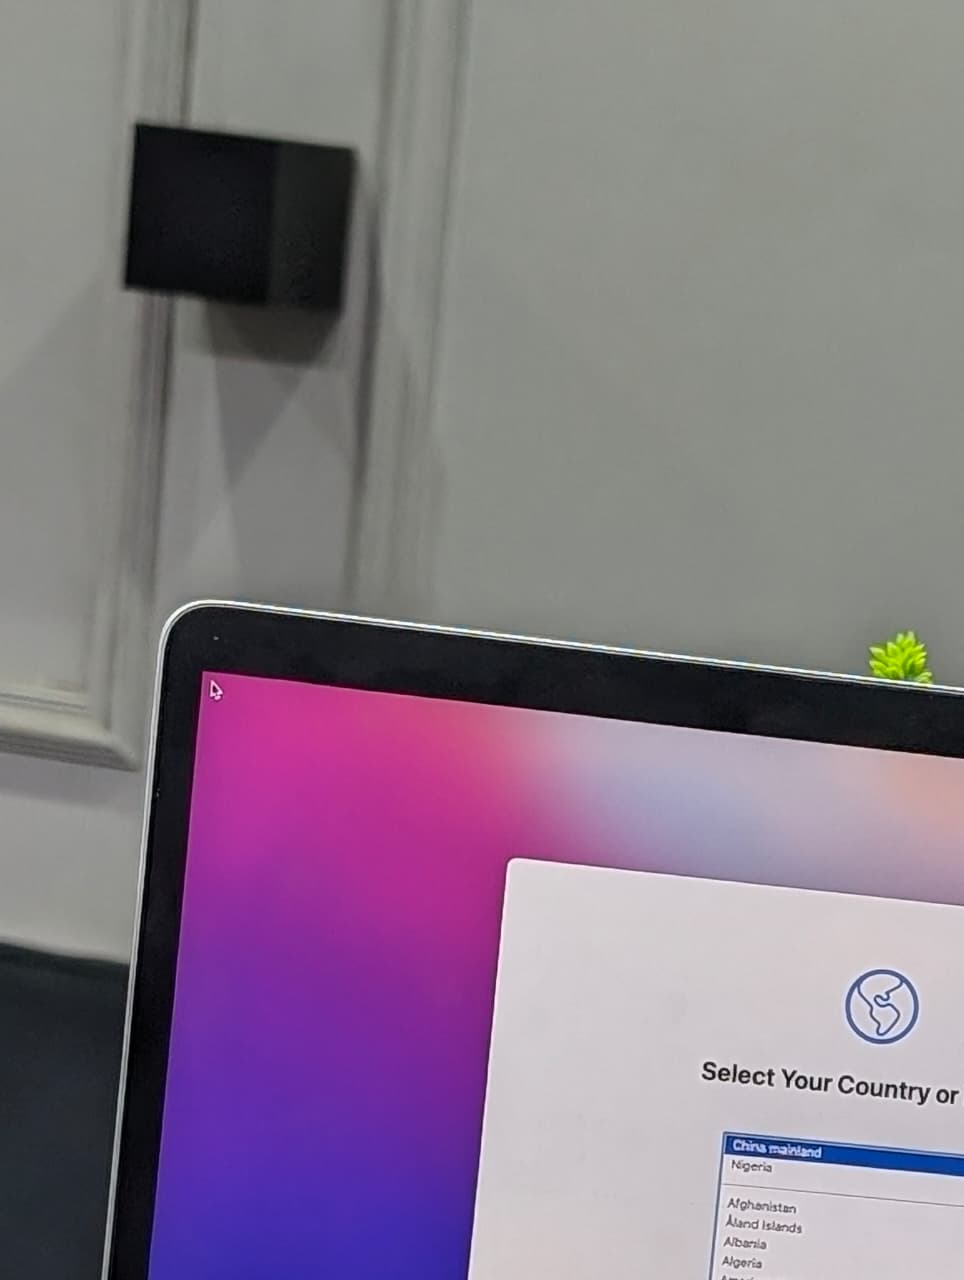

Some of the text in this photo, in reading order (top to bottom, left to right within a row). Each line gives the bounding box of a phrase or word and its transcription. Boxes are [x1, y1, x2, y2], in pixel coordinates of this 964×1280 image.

[701, 1061, 774, 1088] Select
[781, 1068, 833, 1093] Your
[837, 1075, 930, 1105] Country
[936, 1089, 959, 1105] or
[732, 1138, 822, 1159] China mainland
[731, 1159, 772, 1174] Nigeria
[727, 1197, 797, 1216] Afghanistan
[725, 1213, 802, 1234] Åland Islands
[723, 1236, 767, 1250] Albania
[721, 1255, 762, 1271] Algeria
